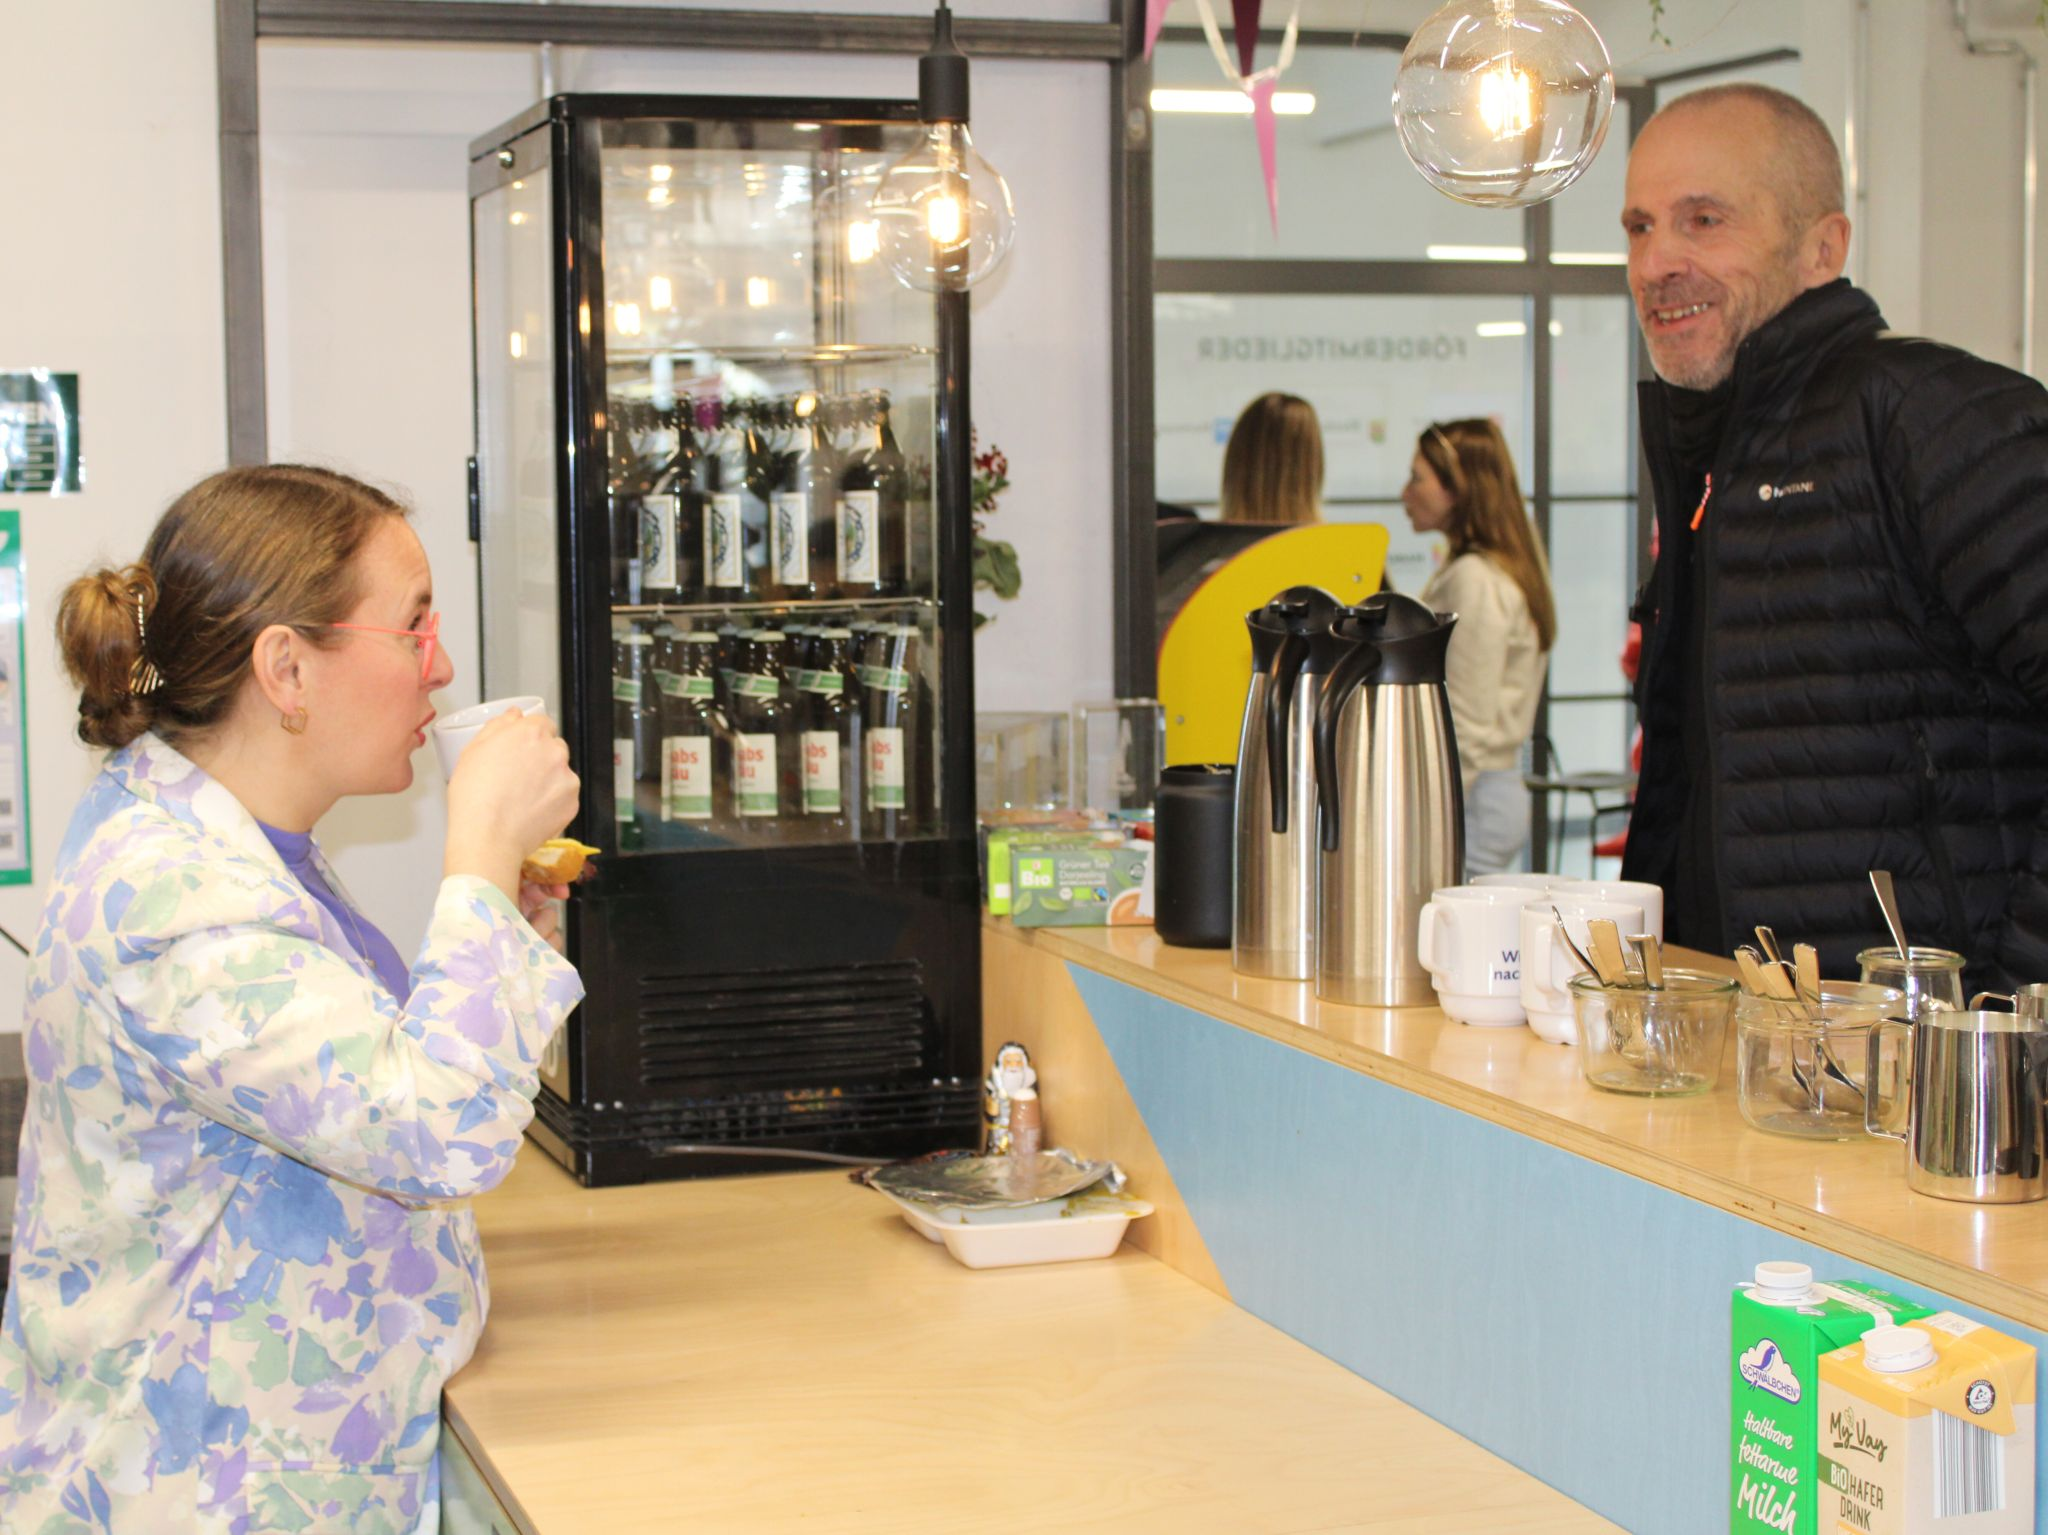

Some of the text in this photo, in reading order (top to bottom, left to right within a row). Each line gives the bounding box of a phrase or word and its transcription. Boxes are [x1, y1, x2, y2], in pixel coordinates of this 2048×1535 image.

[1743, 1409, 1794, 1450] Haltbare
[1829, 1411, 1888, 1463] My Vay
[1738, 1434, 1799, 1486] fettarme
[1737, 1472, 1797, 1535] Milch
[1841, 1495, 1872, 1532] DRINK
[1849, 1474, 1884, 1511] HAFER
